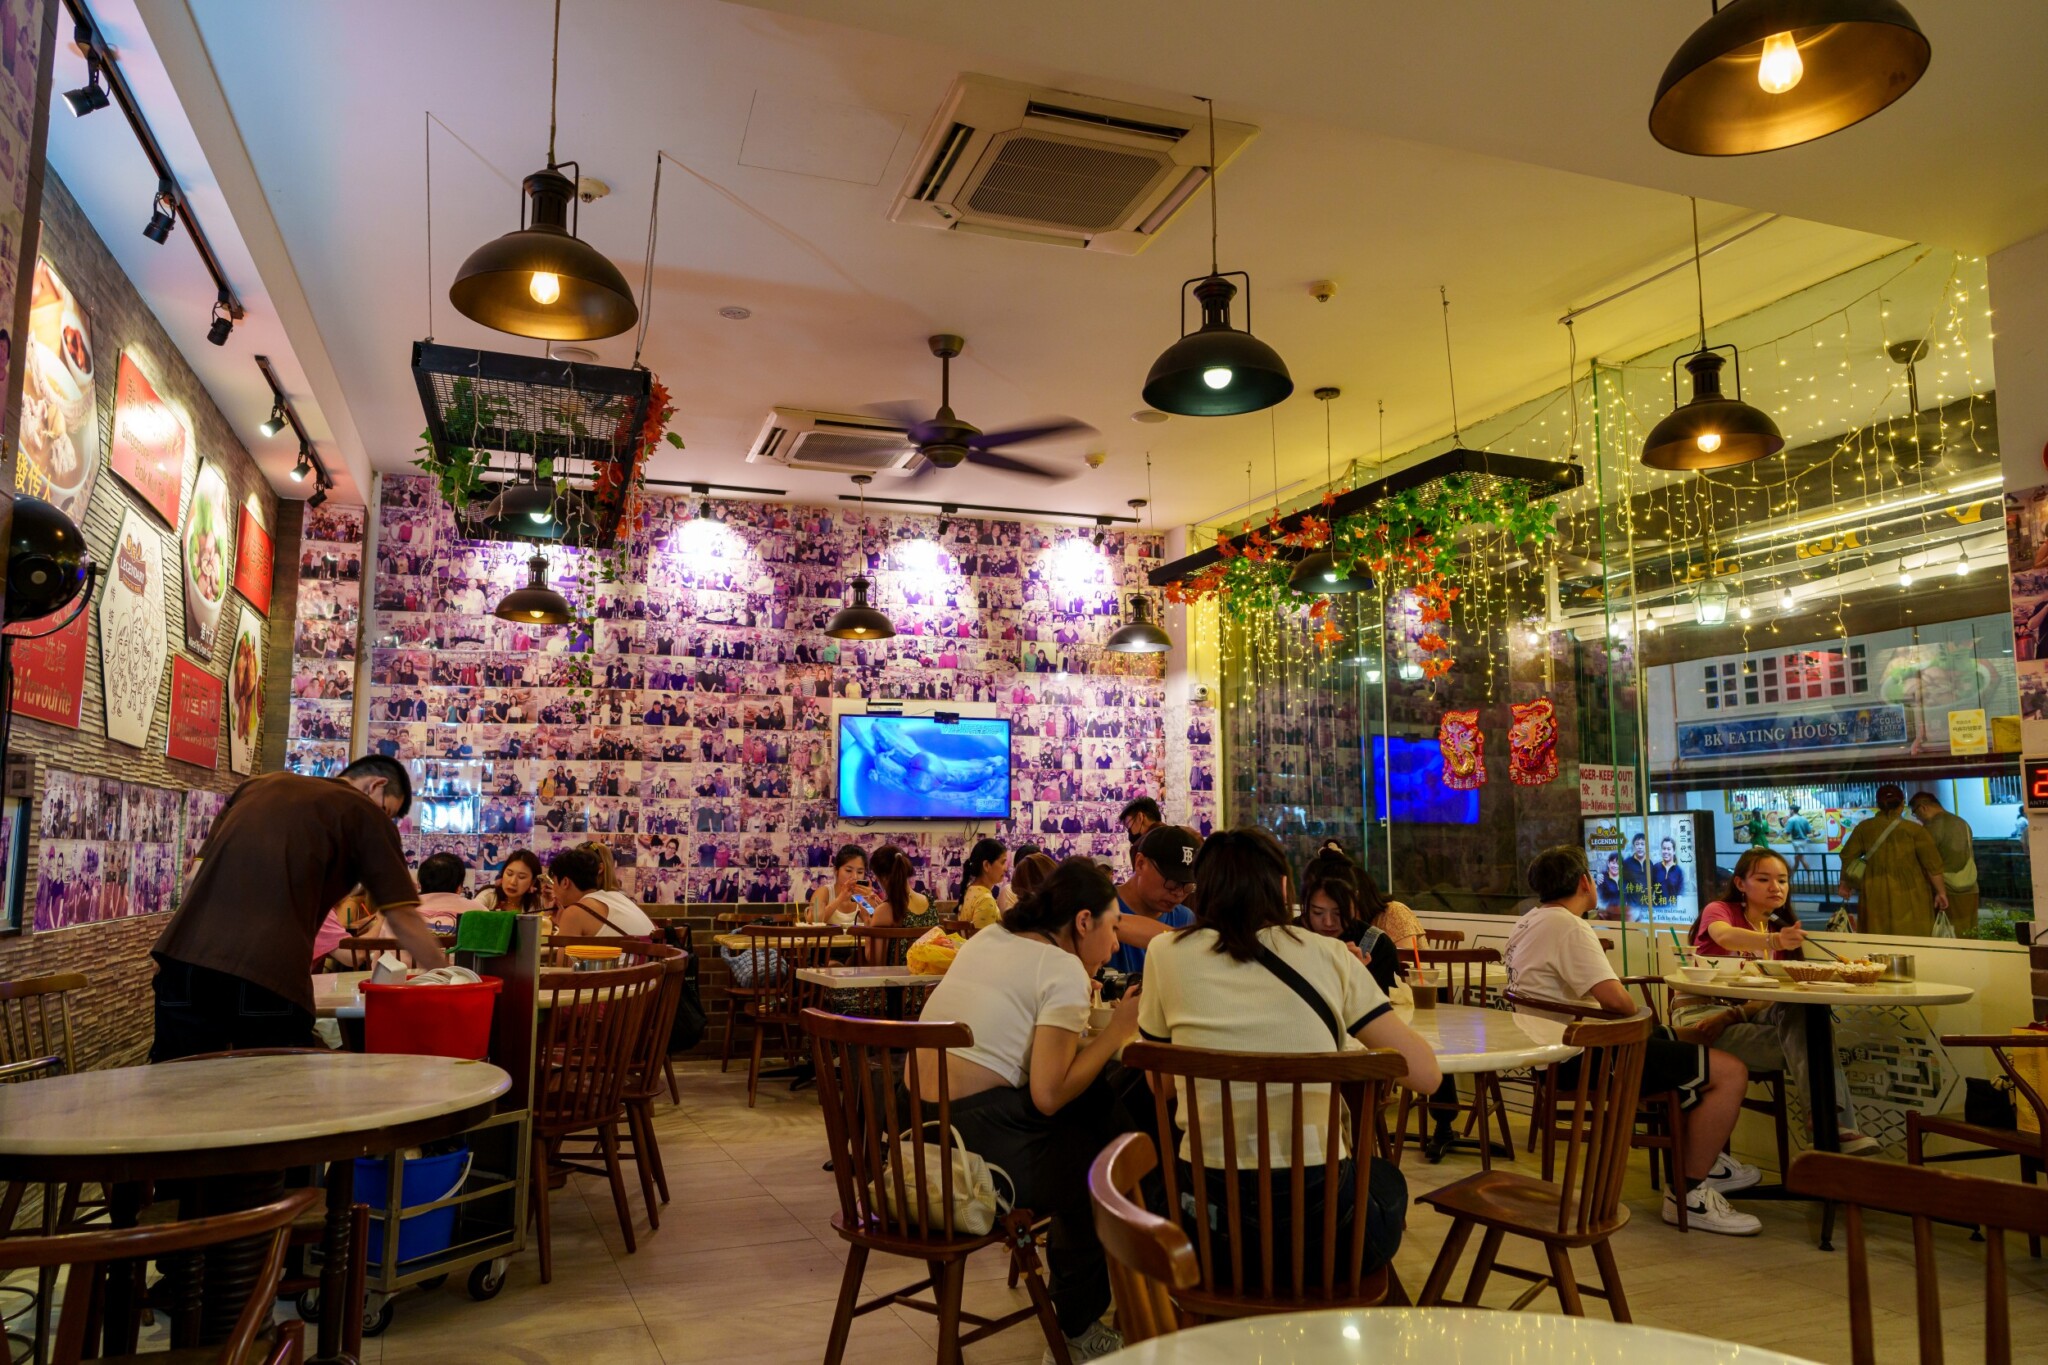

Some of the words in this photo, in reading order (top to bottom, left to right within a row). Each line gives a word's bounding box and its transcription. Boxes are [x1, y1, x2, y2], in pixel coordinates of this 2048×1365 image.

[1704, 732, 1723, 747] BK
[1728, 728, 1785, 745] EATING
[1791, 722, 1848, 739] HOUSE
[1511, 764, 1557, 785] 吉祥如意
